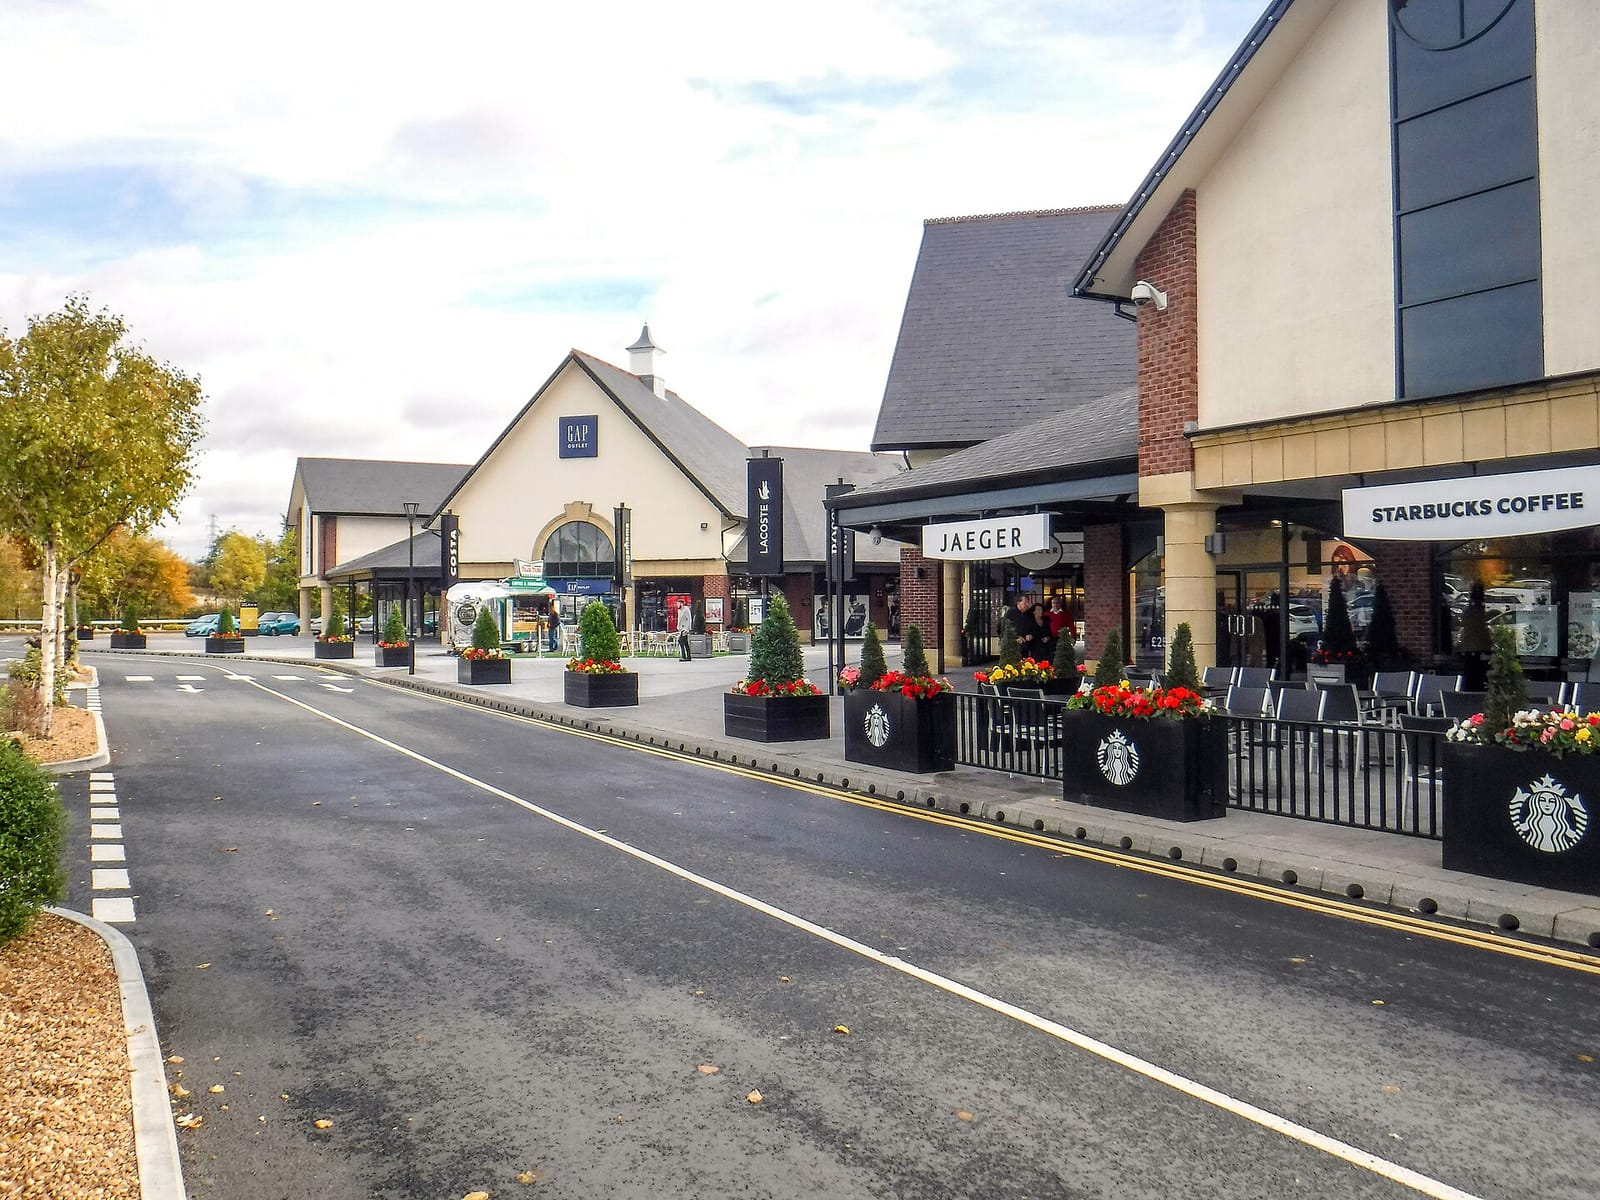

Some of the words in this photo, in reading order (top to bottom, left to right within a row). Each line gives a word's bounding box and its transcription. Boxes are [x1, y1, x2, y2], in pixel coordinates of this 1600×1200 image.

[567, 424, 588, 442] GAP
[1372, 499, 1492, 523] STARBUCKS
[1497, 492, 1584, 514] COFFEE
[759, 504, 769, 554] LACOSTE
[940, 527, 1022, 553] JAEGER
[450, 529, 458, 577] COSTA
